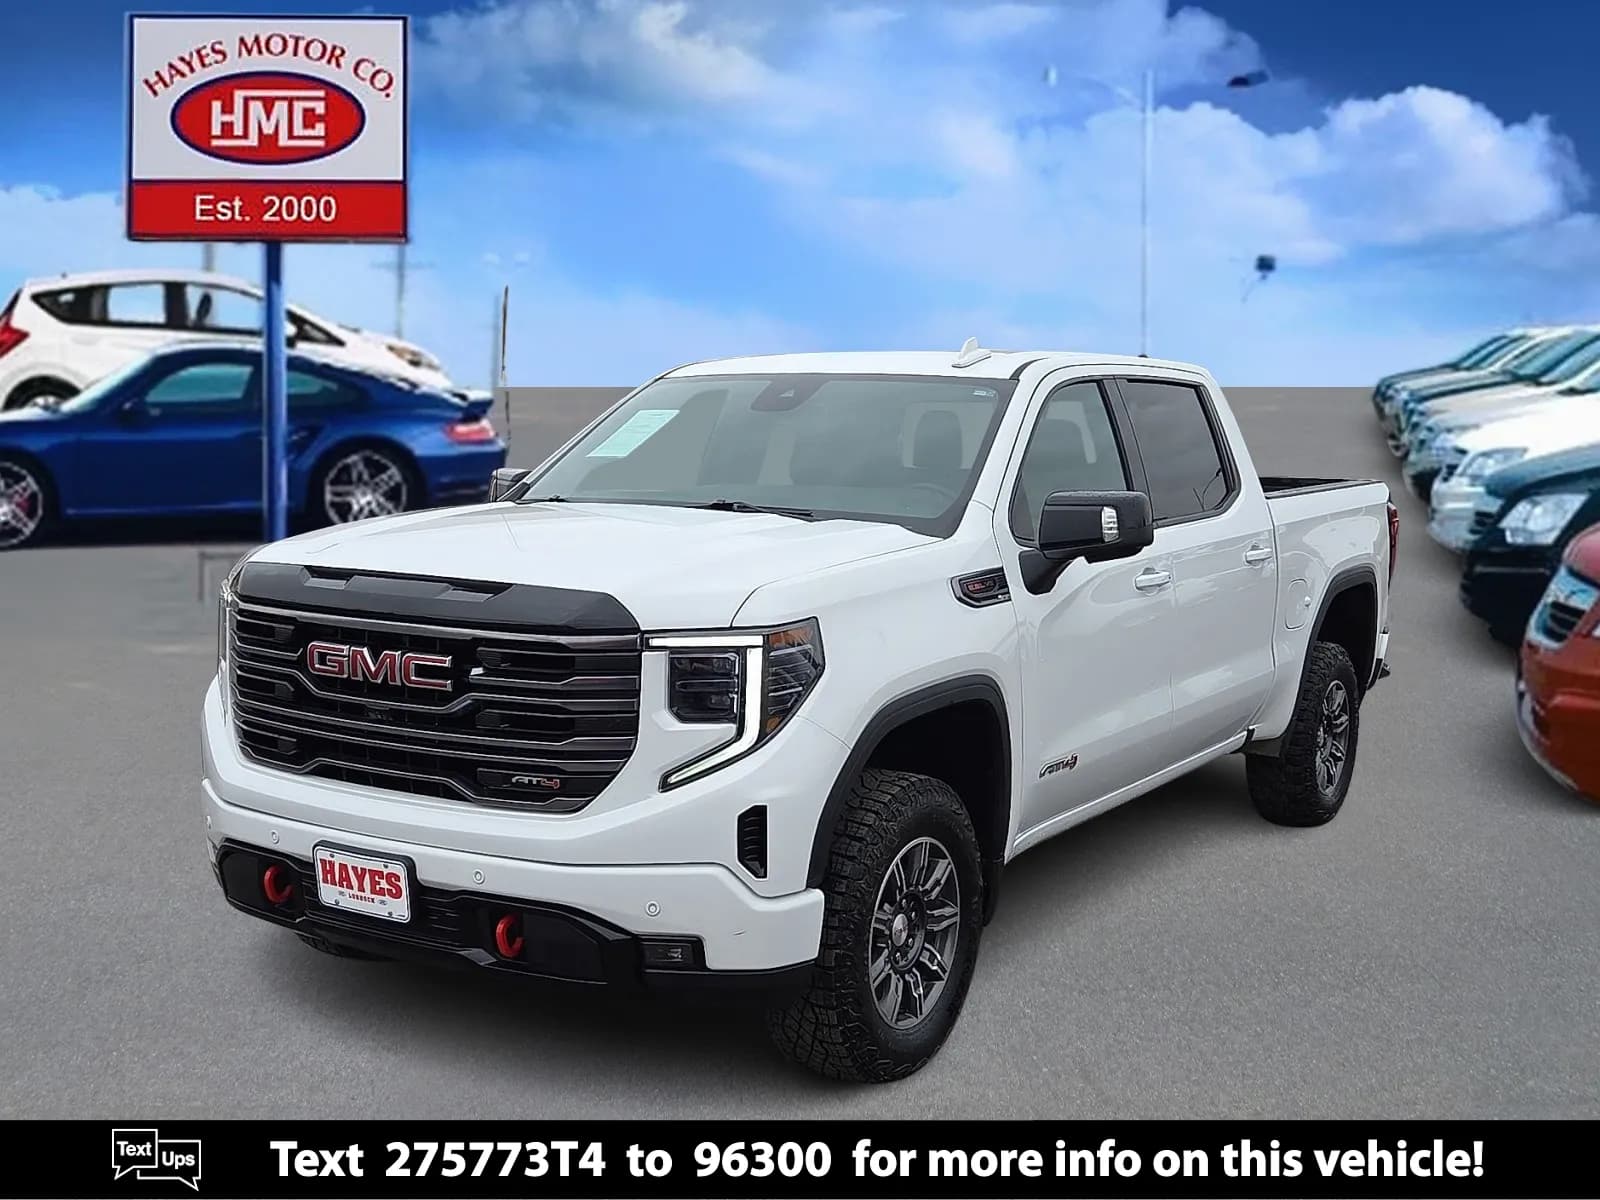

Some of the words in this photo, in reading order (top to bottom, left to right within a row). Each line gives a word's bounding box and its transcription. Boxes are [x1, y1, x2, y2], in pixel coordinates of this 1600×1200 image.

[143, 40, 228, 97] HAYES
[238, 33, 346, 69] MOTOR
[353, 57, 395, 98] CO.
[210, 89, 326, 147] HMC
[194, 195, 250, 221] Est.
[262, 196, 337, 222] 2000
[307, 640, 452, 691] GMC
[512, 776, 561, 790] AT4
[319, 858, 403, 900] HAYES
